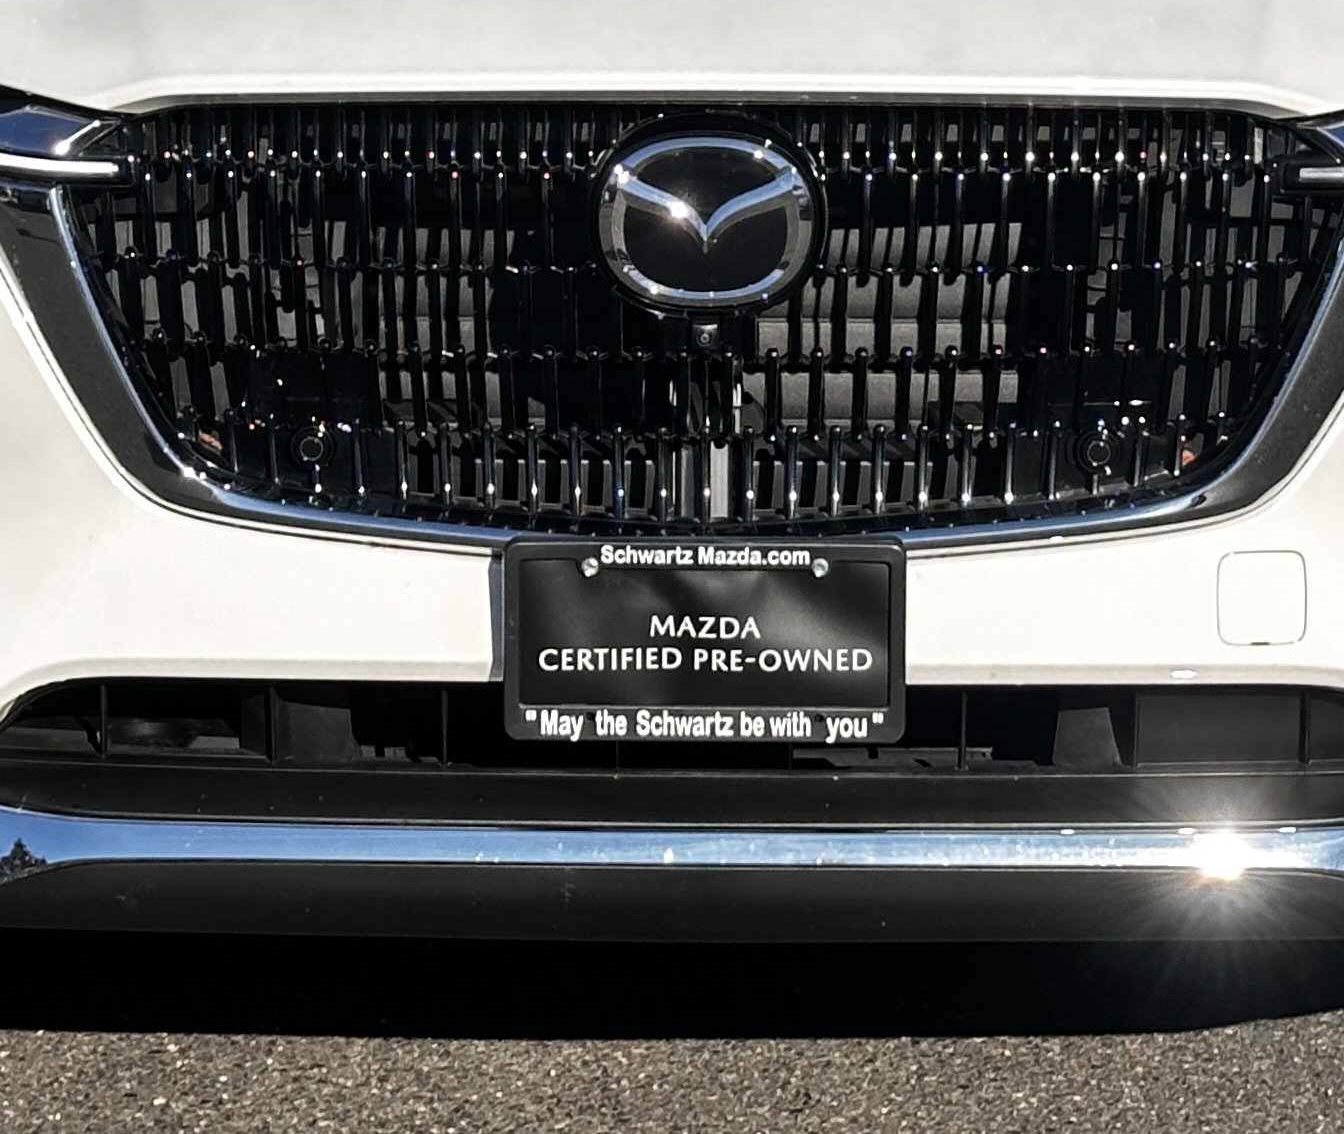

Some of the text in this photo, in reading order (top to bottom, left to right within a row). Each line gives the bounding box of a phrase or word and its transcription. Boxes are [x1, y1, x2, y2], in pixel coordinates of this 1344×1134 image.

[600, 544, 811, 565] Schwartz Mazda.com
[648, 614, 762, 640] MAZDA
[538, 647, 874, 672] CERTIFIED PRE-OWNED
[594, 711, 628, 737] the
[635, 712, 735, 738] Schwartz
[739, 712, 766, 738] be
[768, 711, 813, 738] with
